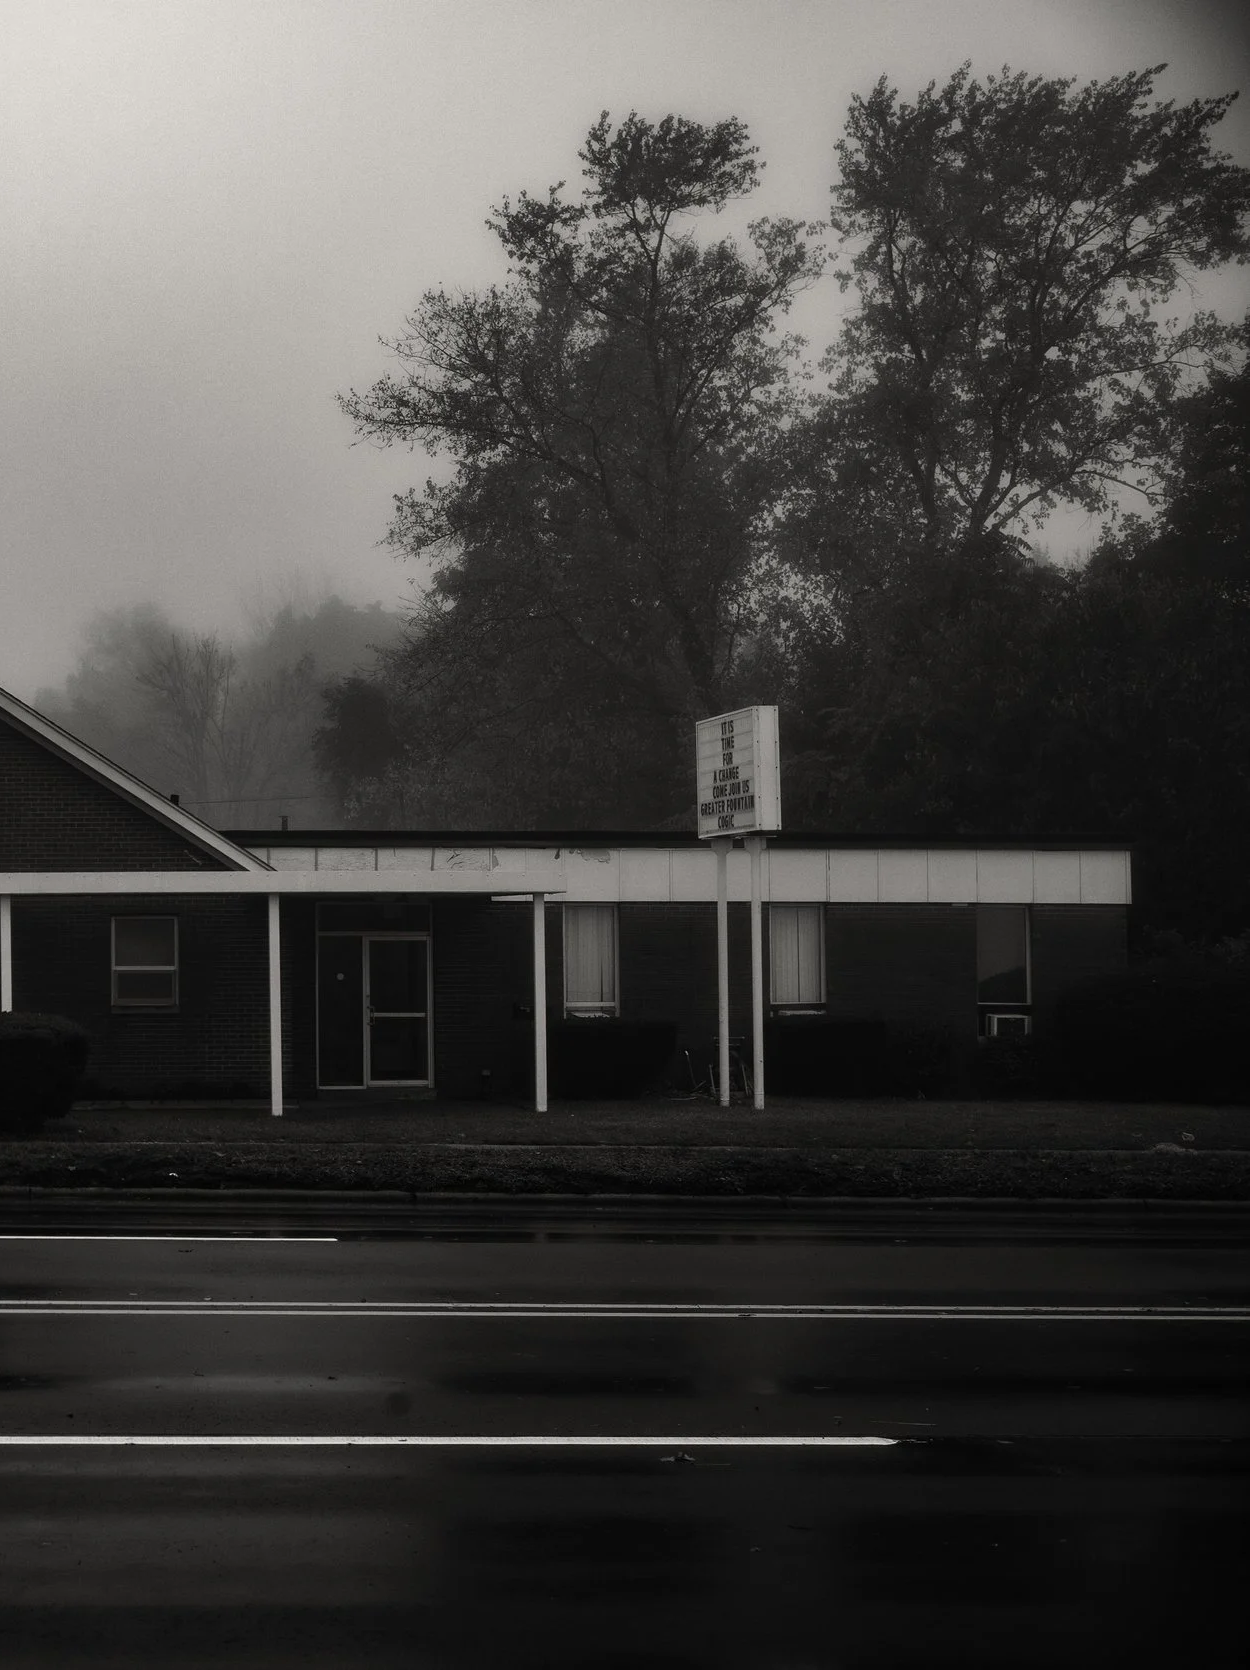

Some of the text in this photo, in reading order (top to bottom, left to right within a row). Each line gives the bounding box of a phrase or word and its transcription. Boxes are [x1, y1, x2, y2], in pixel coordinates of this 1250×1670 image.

[721, 720, 734, 735] IT IS
[722, 736, 734, 750] TIME
[723, 752, 733, 766] FOR
[713, 766, 739, 784] A CHANGE
[713, 780, 749, 799] COME JOIN US
[701, 795, 754, 816] GREATER FOUNTAIN
[718, 815, 734, 829] COGIC
